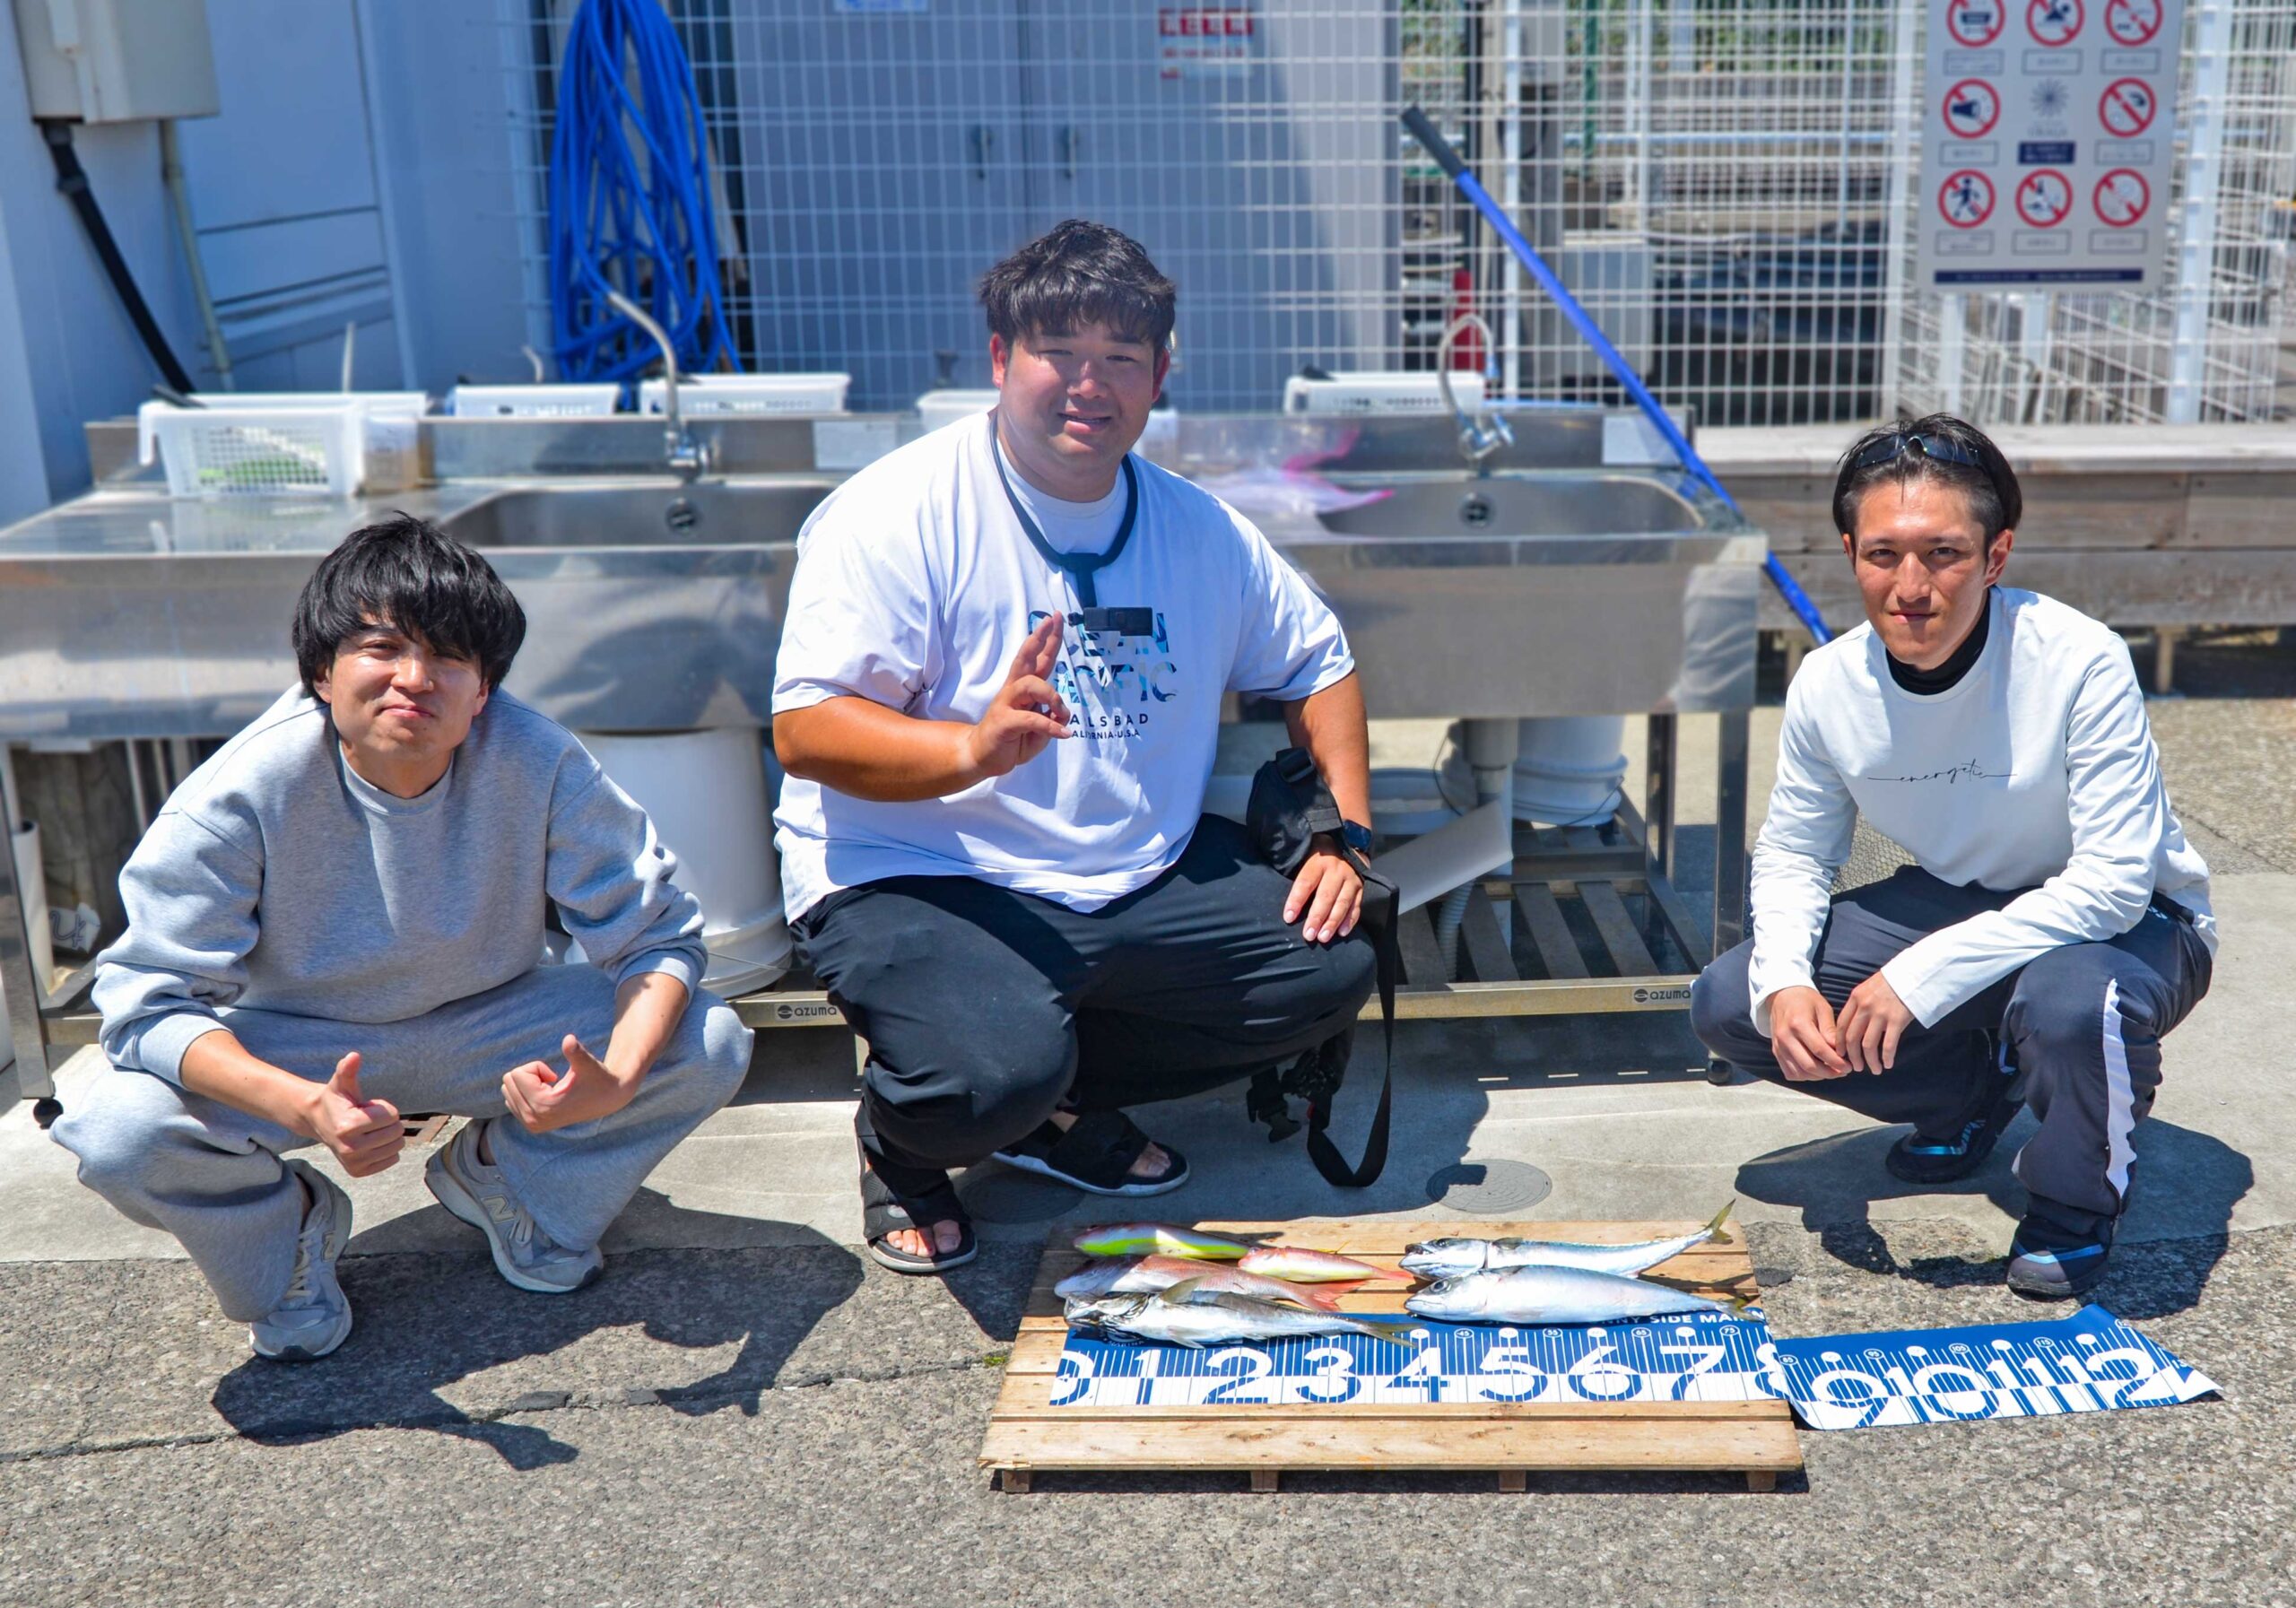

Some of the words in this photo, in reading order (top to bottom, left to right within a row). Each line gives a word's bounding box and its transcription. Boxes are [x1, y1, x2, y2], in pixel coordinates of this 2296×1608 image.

[1650, 989, 1691, 1000] azuma
[794, 1006, 837, 1017] azuma
[1650, 1315, 1693, 1324] SIDE
[1135, 1349, 1161, 1404] 1
[1202, 1347, 1273, 1404] 2
[1295, 1347, 1361, 1403] 3
[1385, 1347, 1449, 1403] 4
[1479, 1346, 1548, 1402] 5
[1568, 1345, 1643, 1401] 6
[1659, 1345, 1726, 1401] 7
[1812, 1369, 1889, 1428] 9
